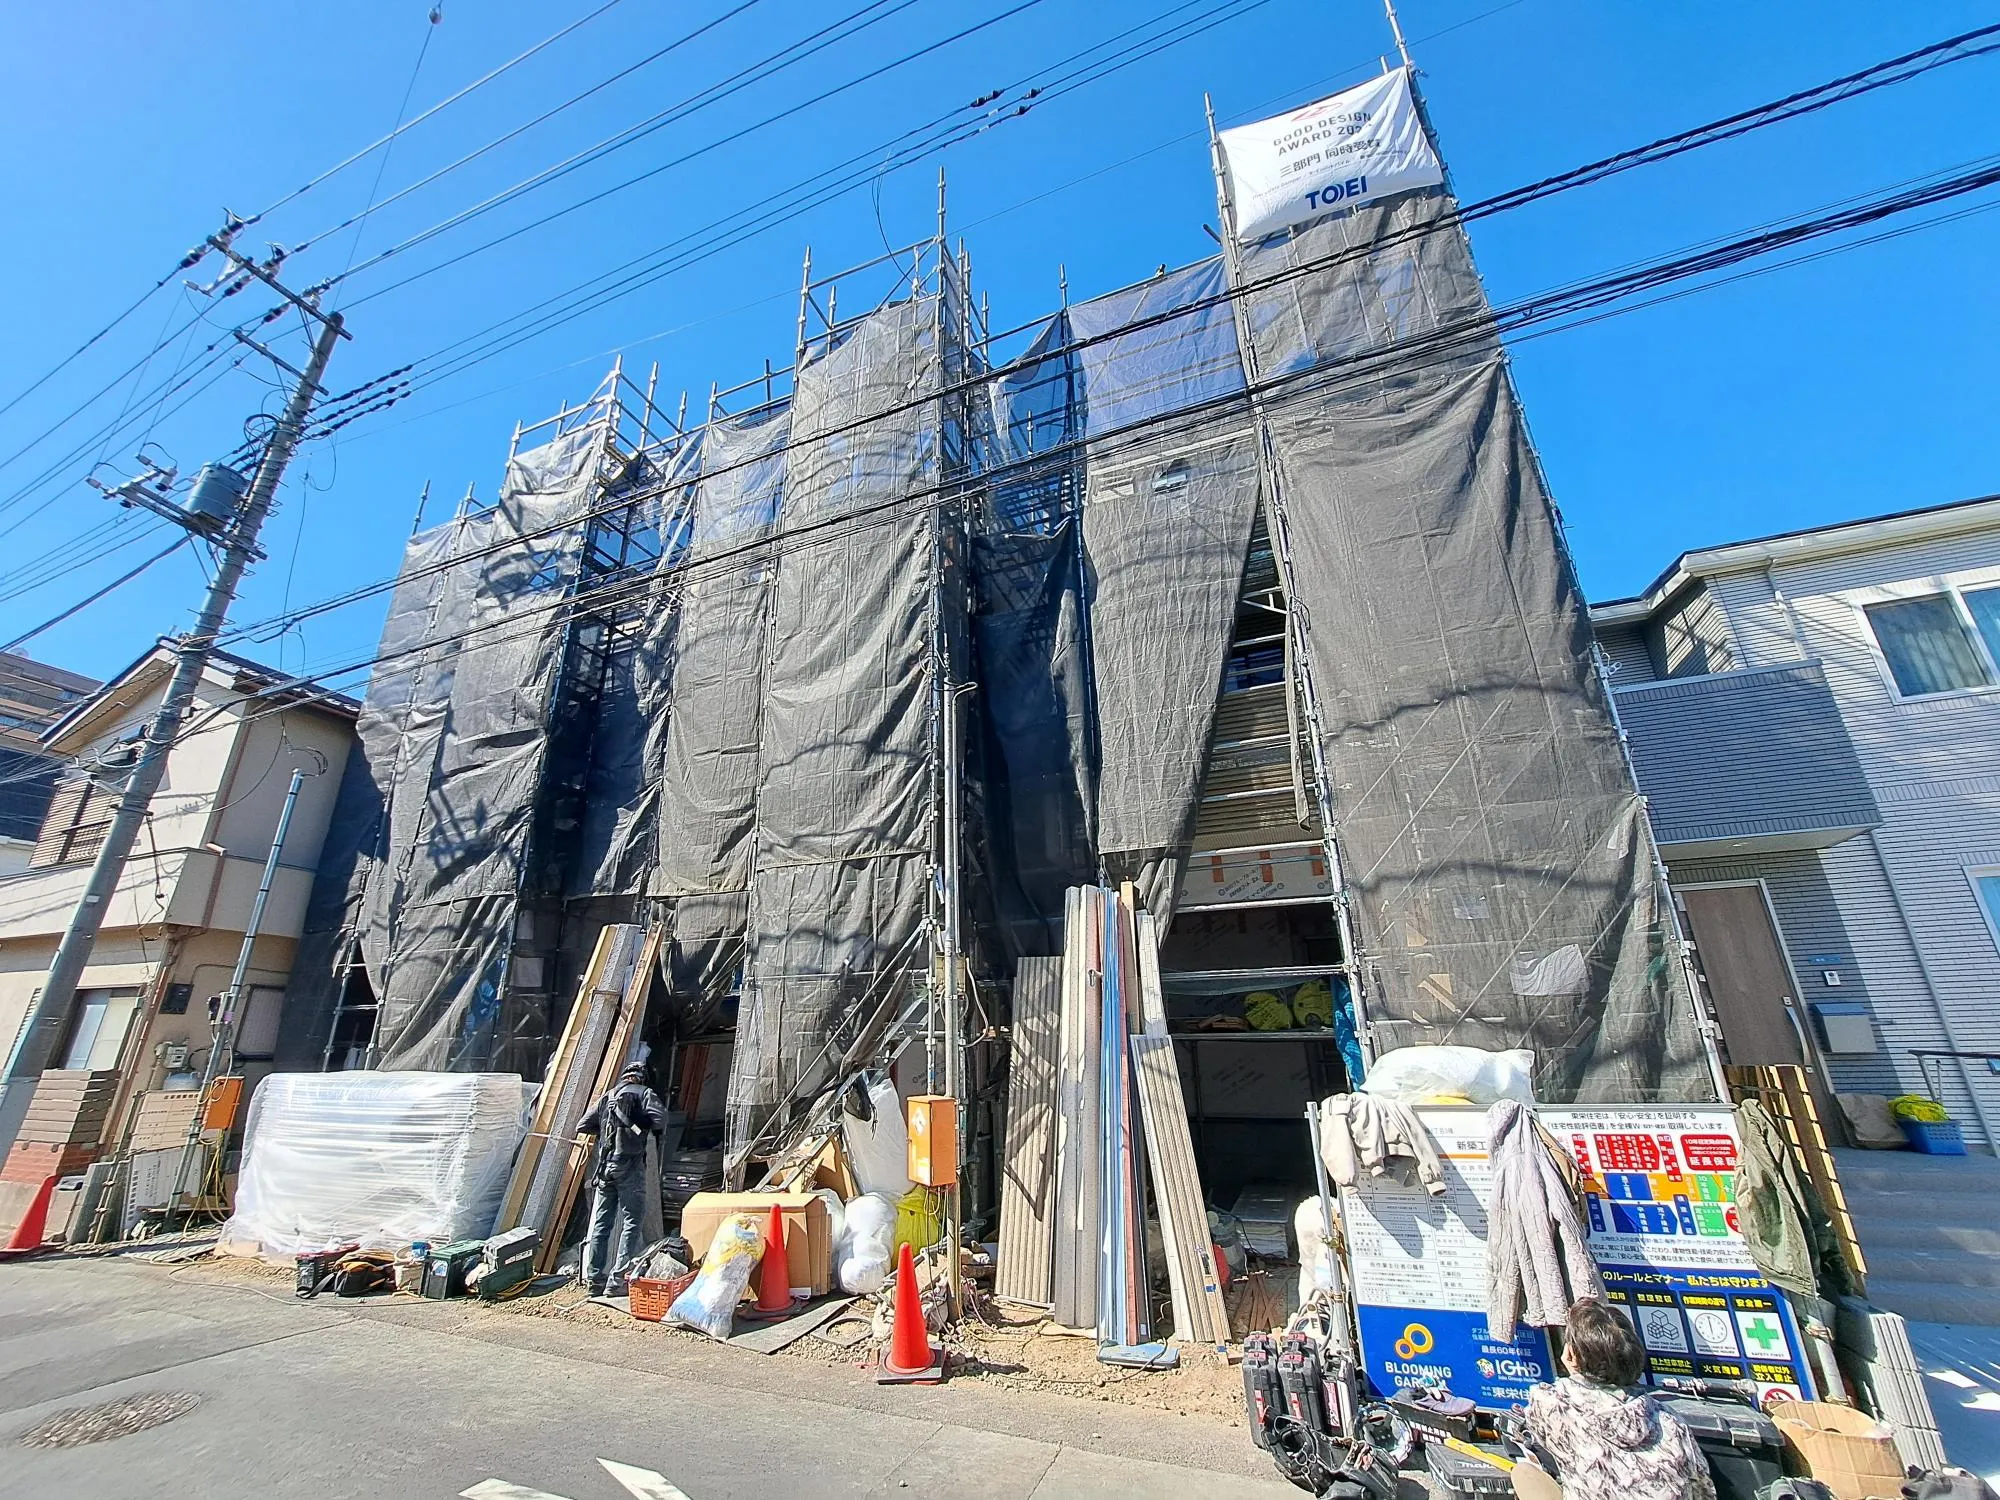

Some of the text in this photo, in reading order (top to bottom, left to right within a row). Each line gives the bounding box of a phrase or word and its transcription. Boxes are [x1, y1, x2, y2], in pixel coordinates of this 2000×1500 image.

[1273, 112, 1372, 147] GOOD DESIGN
[1278, 129, 1332, 157] AWARD
[1280, 152, 1321, 178] 三部門
[1602, 1270, 1769, 1289] のルールとマナー 私たちは守ります
[1735, 1298, 1773, 1309] 安全第一
[1384, 1361, 1452, 1379] BLOOMING
